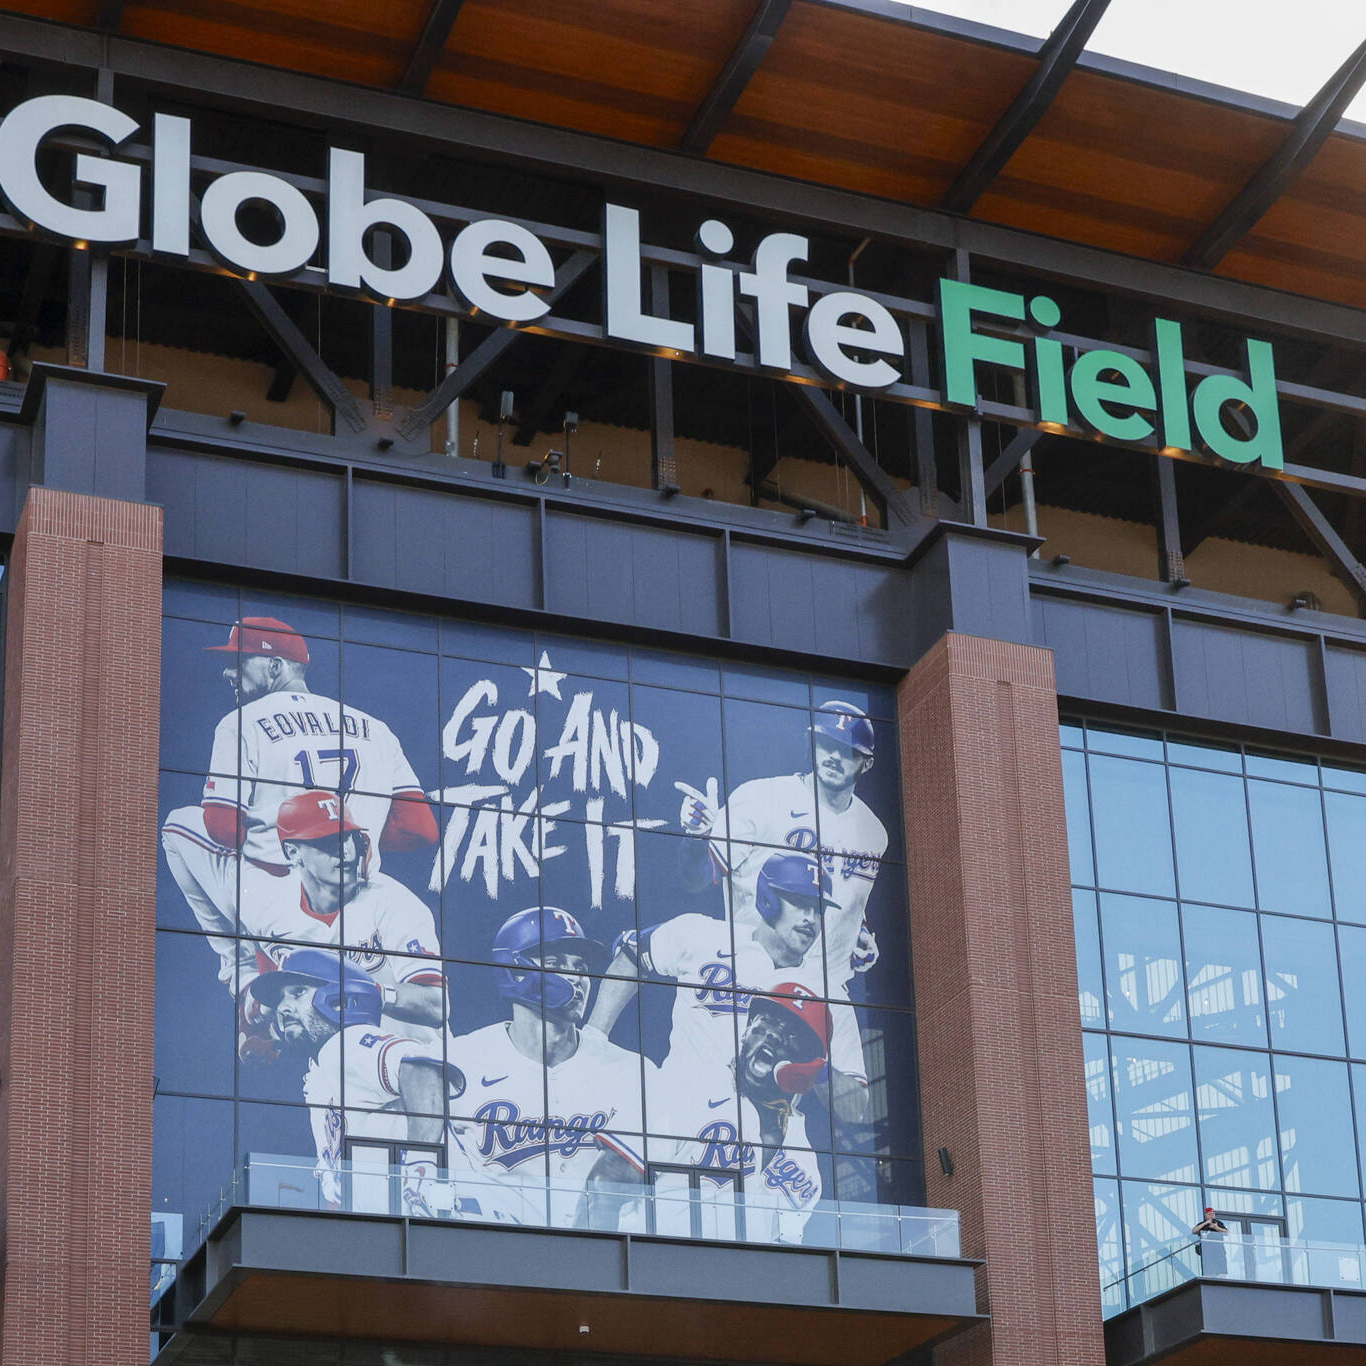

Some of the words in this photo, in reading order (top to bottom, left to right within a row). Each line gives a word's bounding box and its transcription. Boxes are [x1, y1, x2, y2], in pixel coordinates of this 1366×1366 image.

[606, 202, 904, 388] Life
[941, 276, 1285, 470] Field
[257, 711, 371, 743] EOVALDI
[294, 748, 361, 803] 17
[442, 680, 536, 786] GO
[543, 691, 660, 801] AND
[426, 783, 572, 900] TAKE
[585, 796, 671, 910] IT
